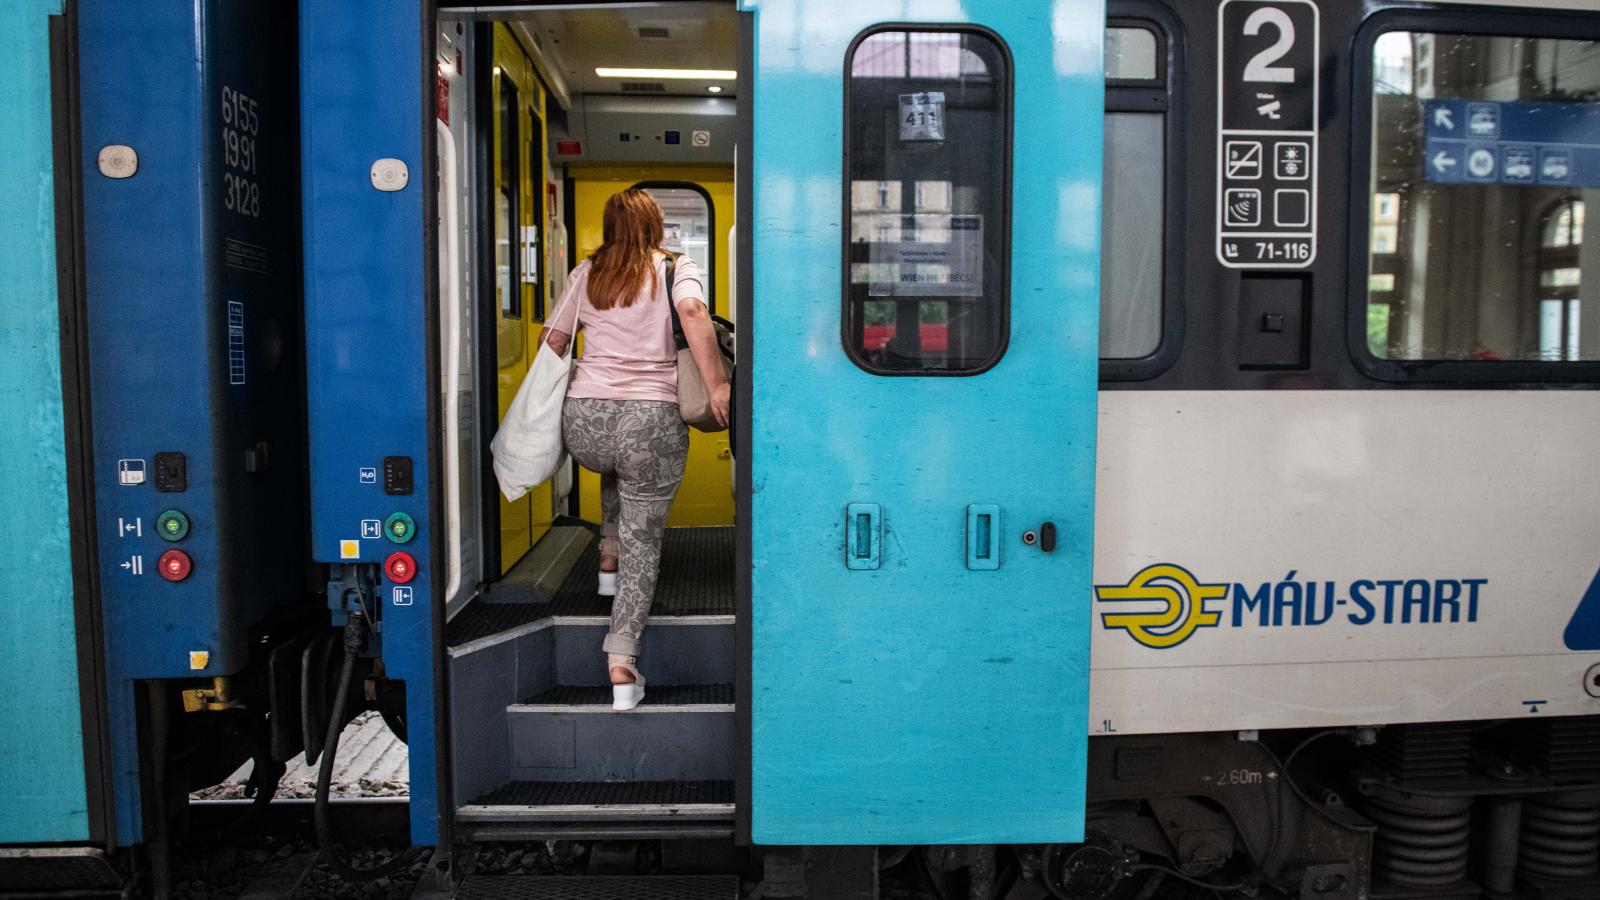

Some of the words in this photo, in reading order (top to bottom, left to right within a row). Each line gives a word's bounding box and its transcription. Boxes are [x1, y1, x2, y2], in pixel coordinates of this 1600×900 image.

[1242, 7, 1295, 82] 2
[222, 85, 258, 136] 6155
[223, 126, 256, 175] 1991
[224, 172, 260, 218] 3128
[1256, 243, 1309, 259] 71-116
